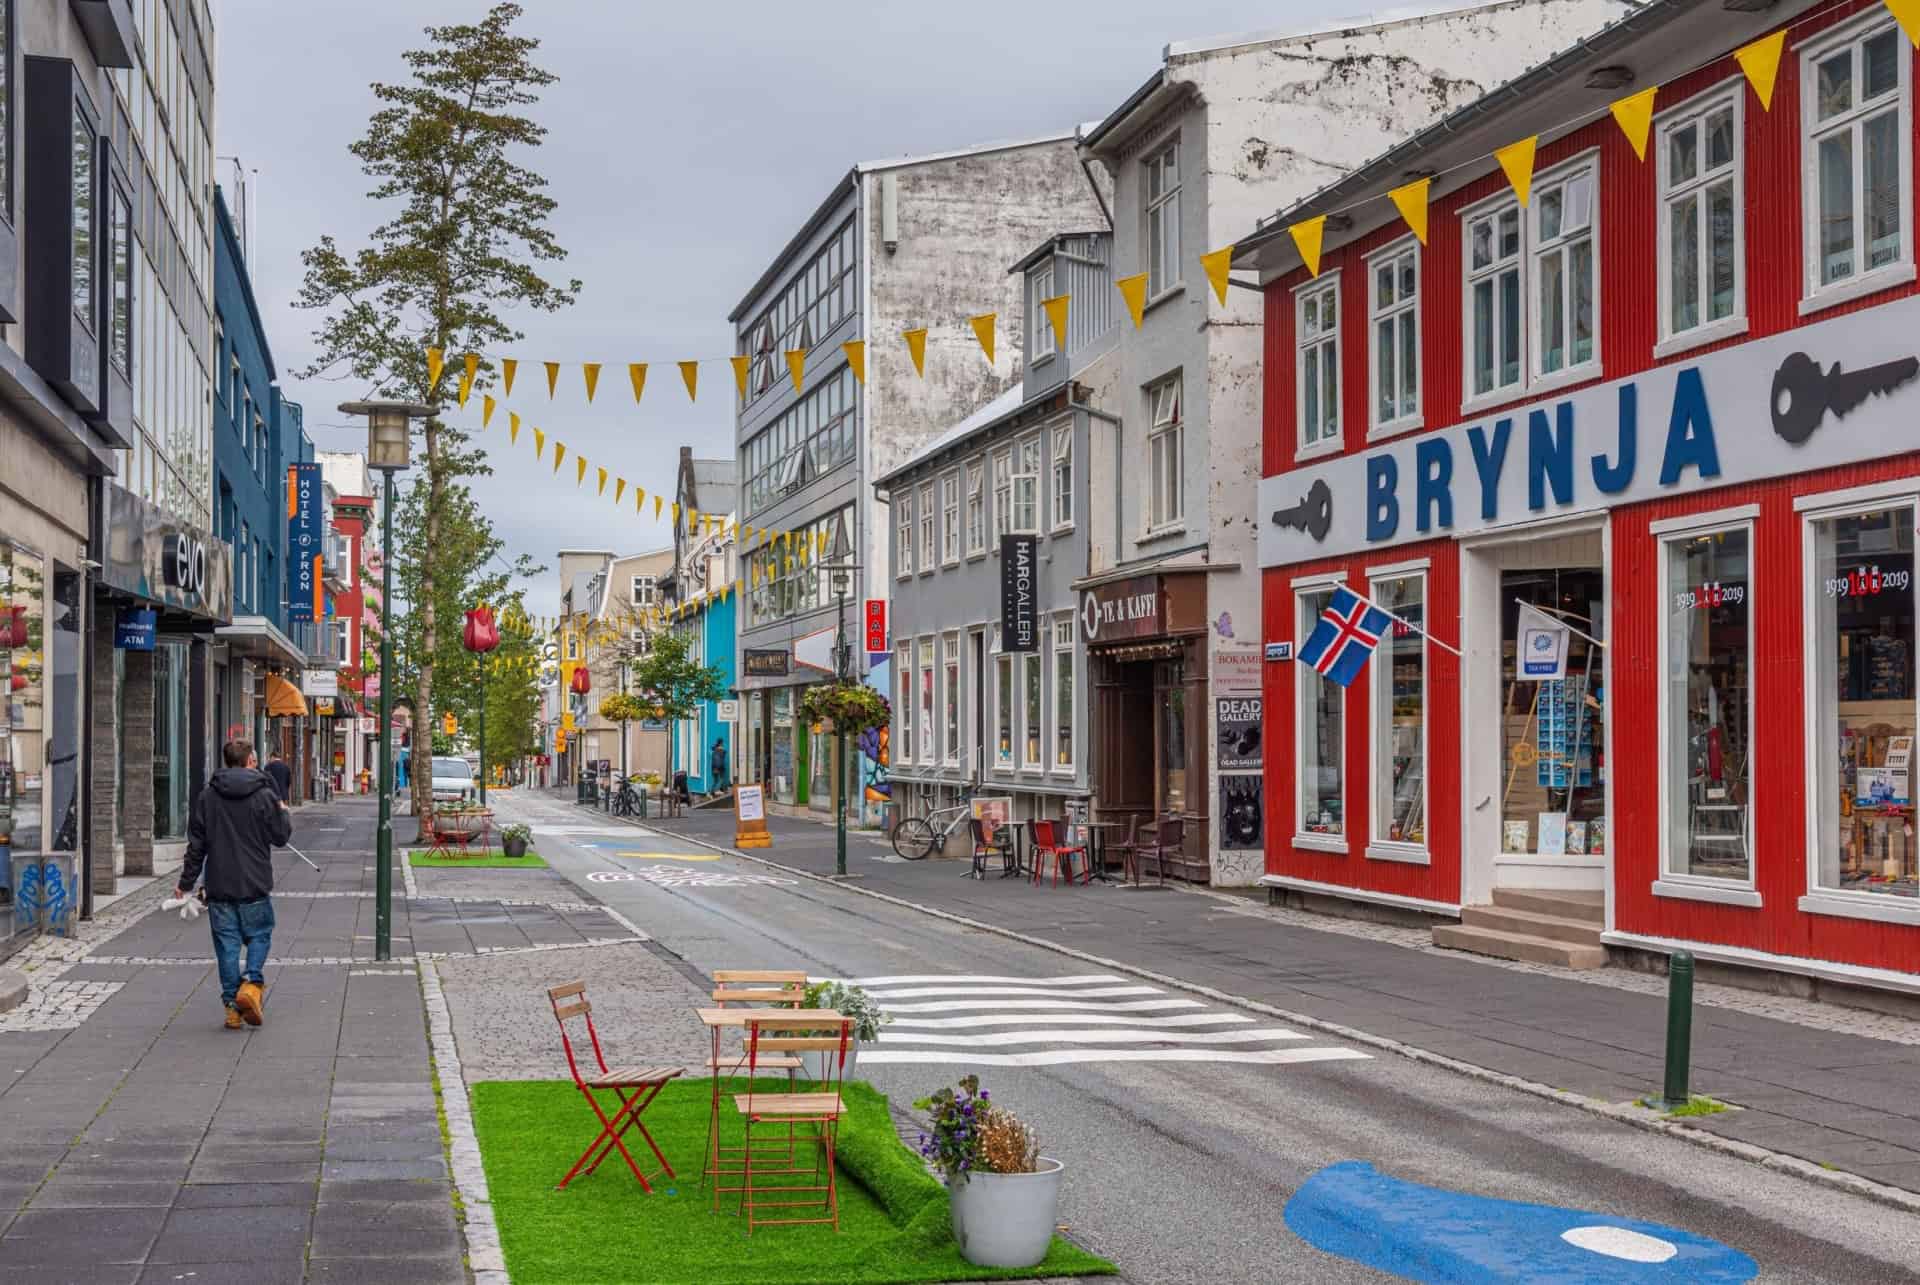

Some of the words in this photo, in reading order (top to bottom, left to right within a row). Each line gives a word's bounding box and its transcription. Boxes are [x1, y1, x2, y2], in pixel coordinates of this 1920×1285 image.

[1366, 366, 1721, 542] BRYNJA
[1825, 577, 1848, 598] 1919
[1882, 570, 1909, 591] 2019
[1102, 600, 1115, 623] TE
[1128, 593, 1156, 619] KAFFI
[1677, 591, 1696, 609] 1919
[1722, 586, 1744, 604] 2019
[870, 602, 881, 649] BAR
[124, 635, 145, 645] ATM
[1219, 700, 1262, 714] DEAD
[1220, 712, 1262, 721] GALLERY
